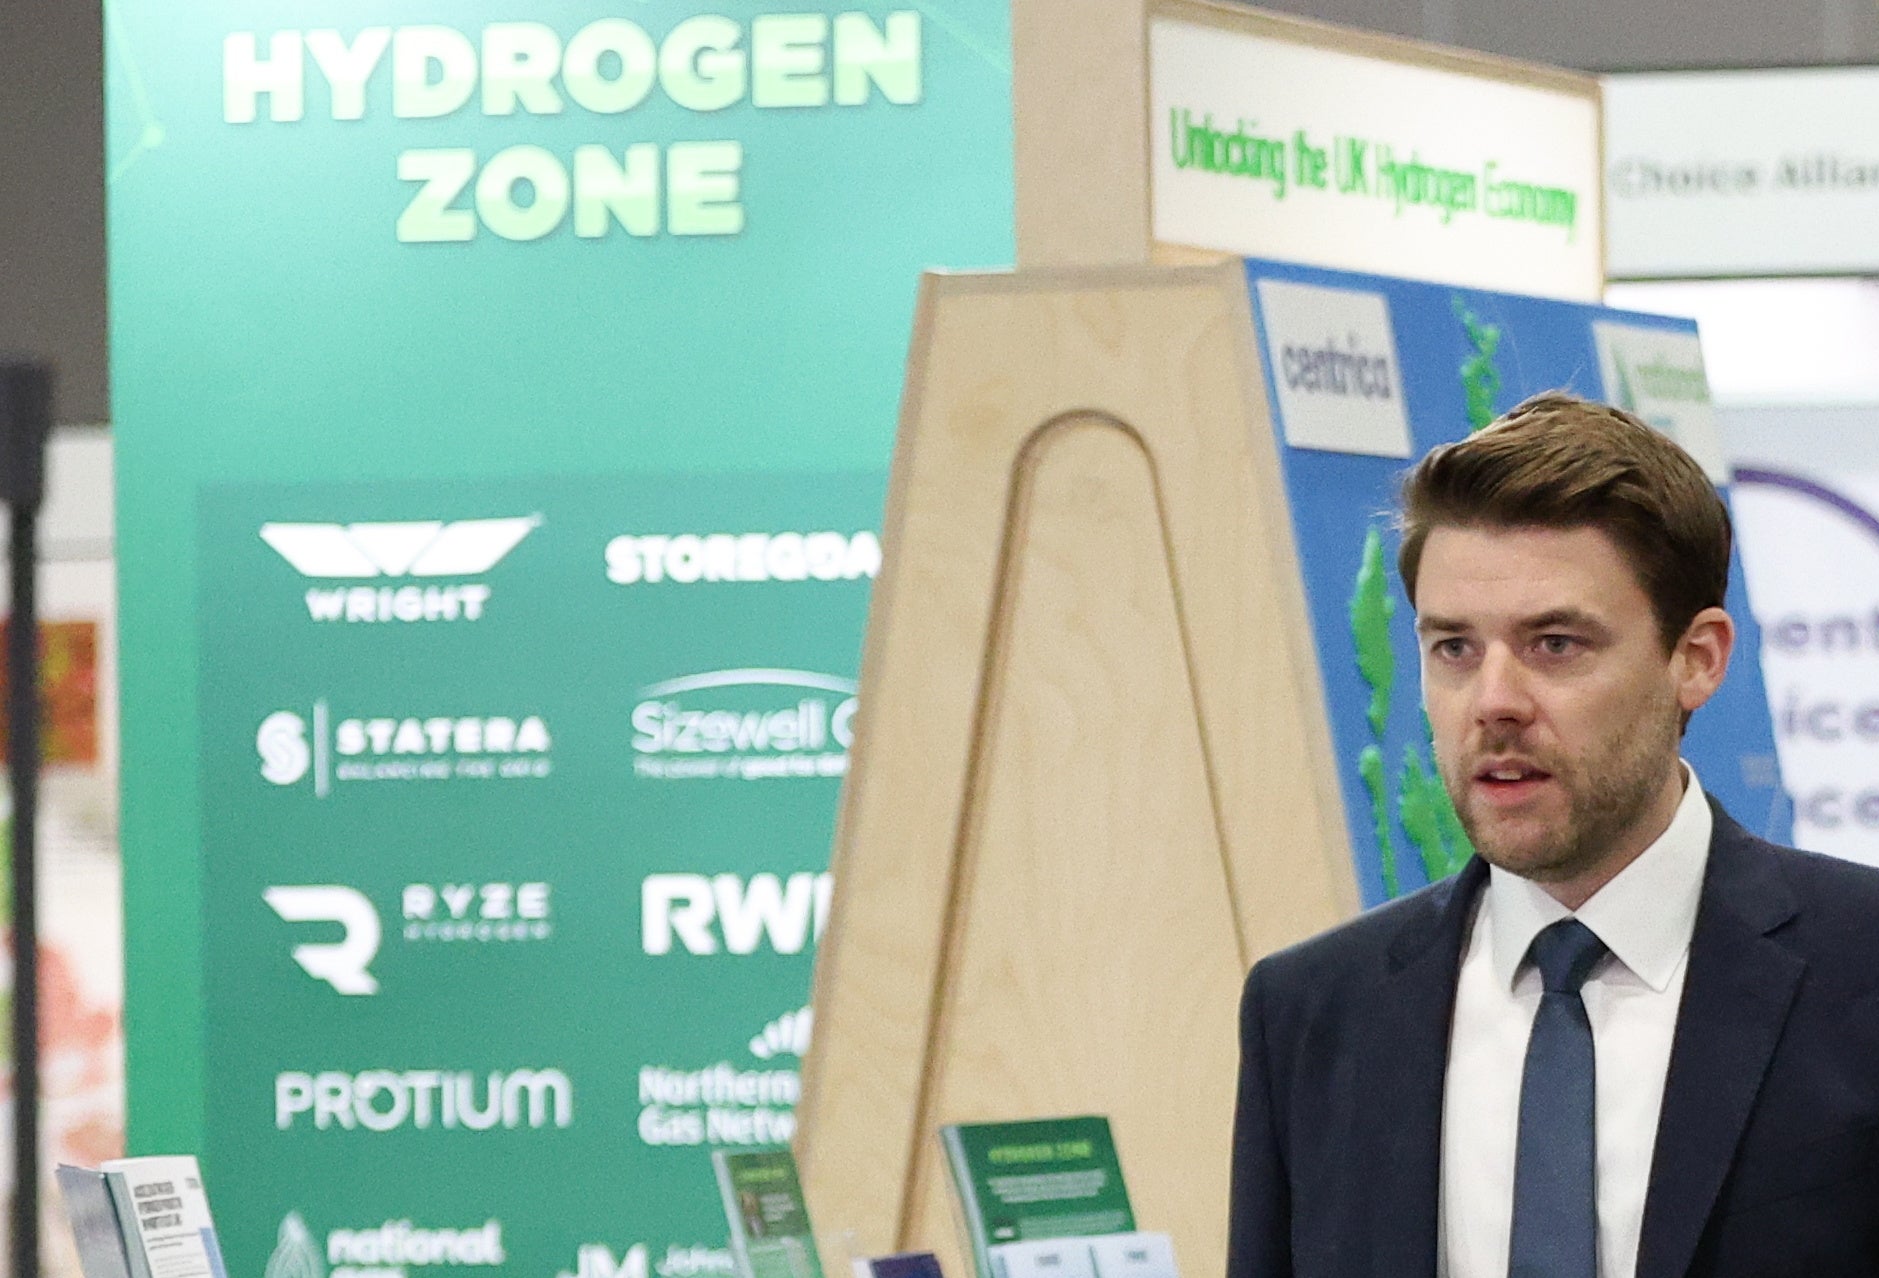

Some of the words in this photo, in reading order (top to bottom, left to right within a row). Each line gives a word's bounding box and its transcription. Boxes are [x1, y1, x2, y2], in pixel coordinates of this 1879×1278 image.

[223, 10, 922, 124] HYDROGEN
[396, 140, 744, 243] ZONE
[1169, 106, 1287, 200] Unlocking
[1293, 129, 1328, 189] the
[1334, 134, 1369, 196] UK
[1375, 143, 1477, 227] Hydrogen
[1483, 160, 1578, 245] Economy
[1611, 156, 1757, 197] Choice
[1280, 334, 1391, 401] centrica
[305, 584, 491, 621] WRIGHT
[336, 716, 551, 755] STATERA
[631, 699, 826, 753] Sizewell
[402, 881, 552, 920] RYZE
[275, 1068, 573, 1131] PROTIUM
[638, 1061, 801, 1106] Northern
[638, 1103, 704, 1145] Gas
[706, 1106, 798, 1145] Netw
[327, 1219, 503, 1265] national
